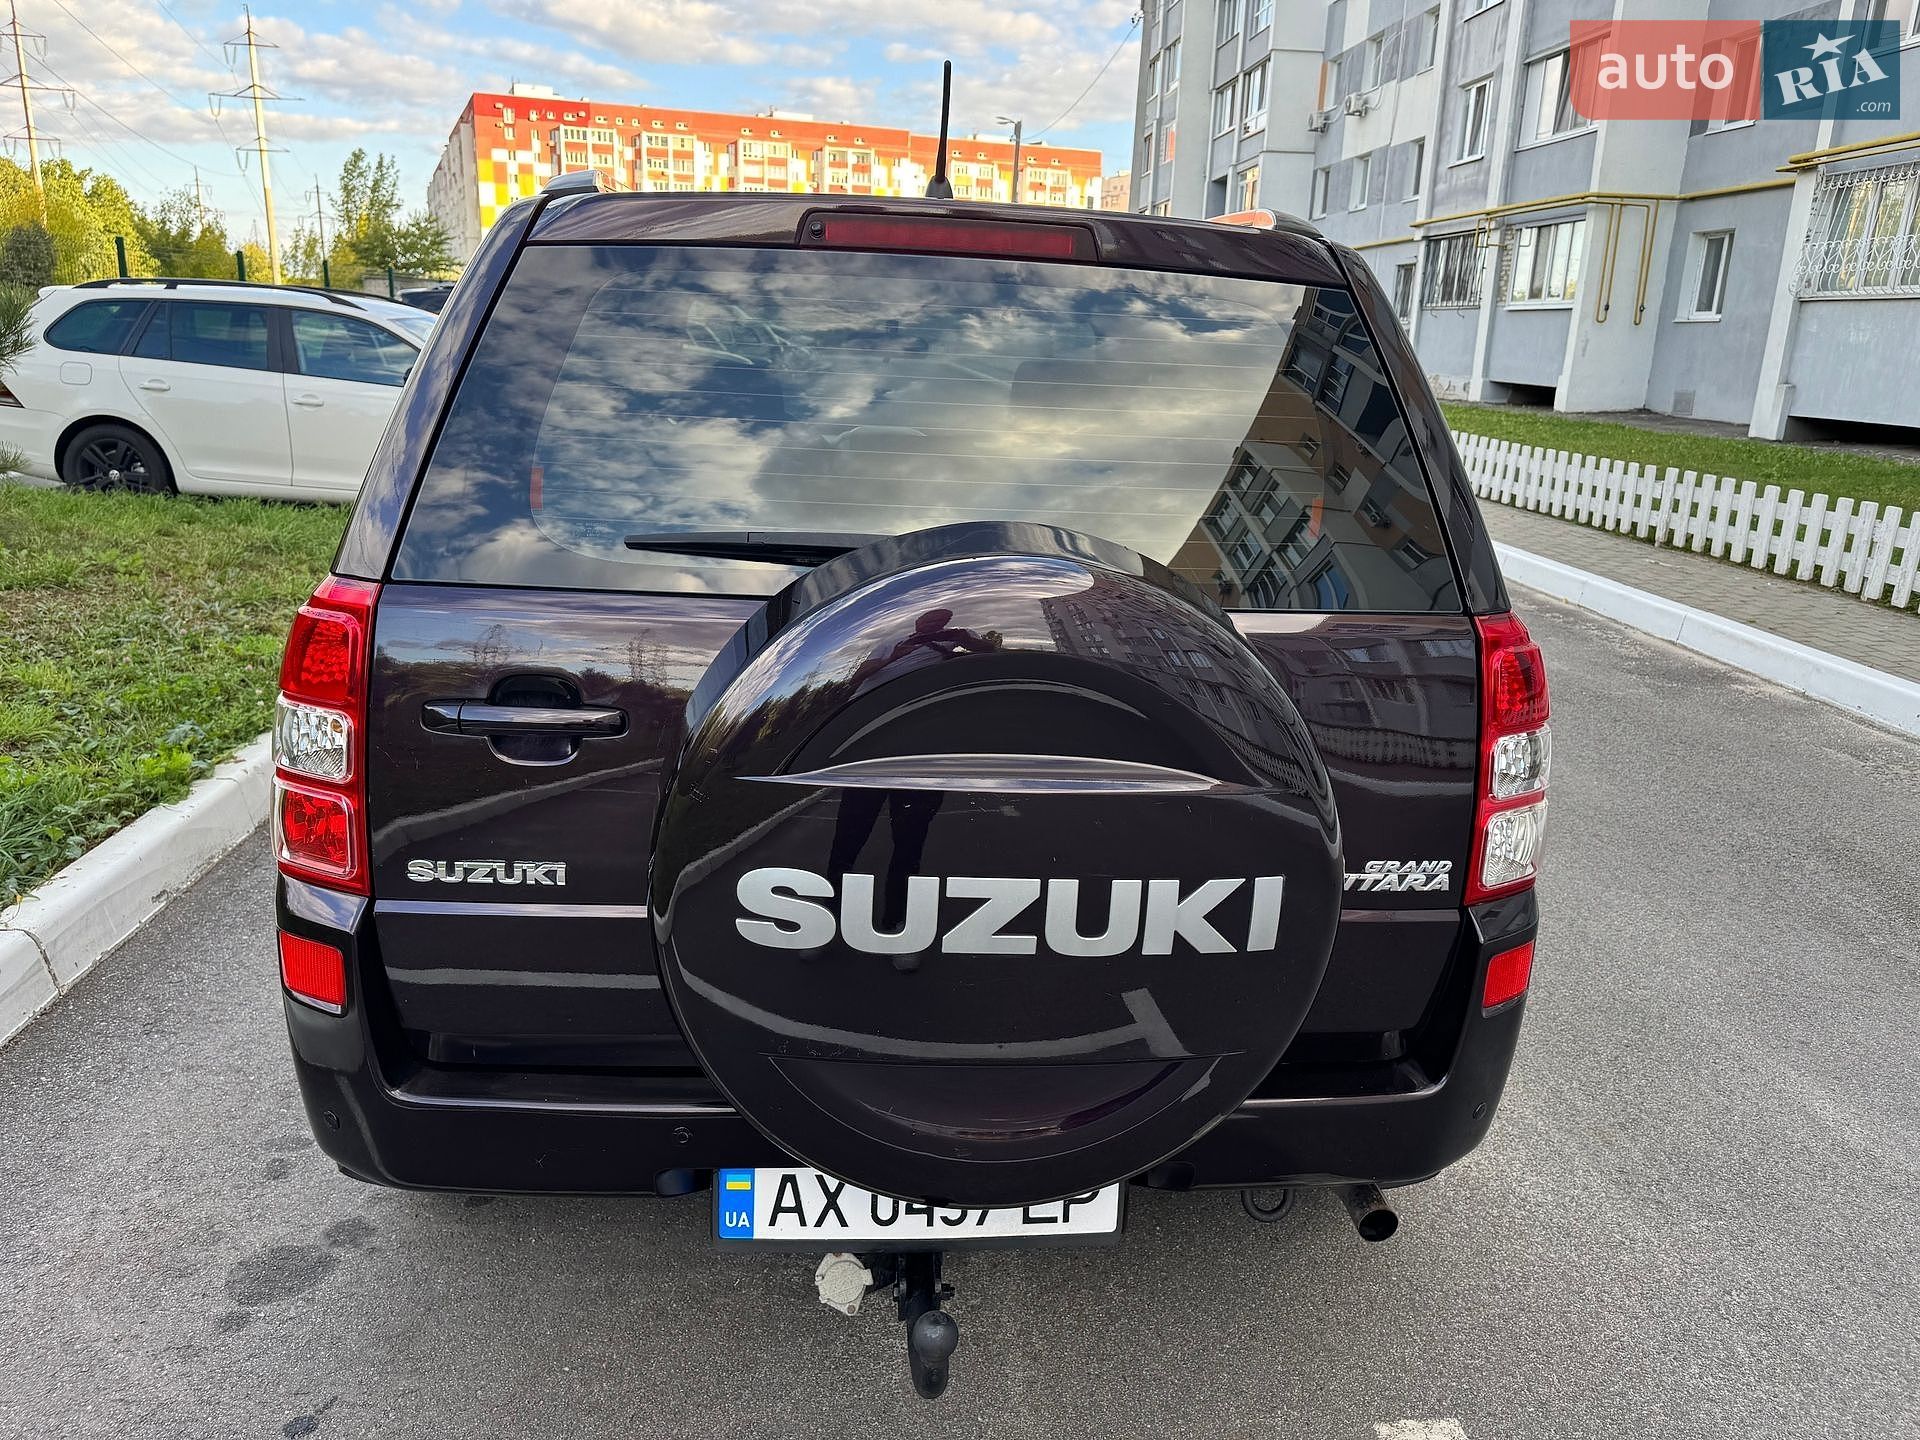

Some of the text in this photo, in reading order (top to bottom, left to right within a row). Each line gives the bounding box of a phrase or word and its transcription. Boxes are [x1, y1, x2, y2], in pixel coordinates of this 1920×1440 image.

[406, 859, 567, 886] SUZUKI
[1364, 860, 1453, 874] GRAND
[1343, 873, 1449, 891] ITARA
[736, 867, 1286, 957] SUZUKI
[768, 1173, 849, 1228] AX
[725, 1211, 750, 1228] UA
